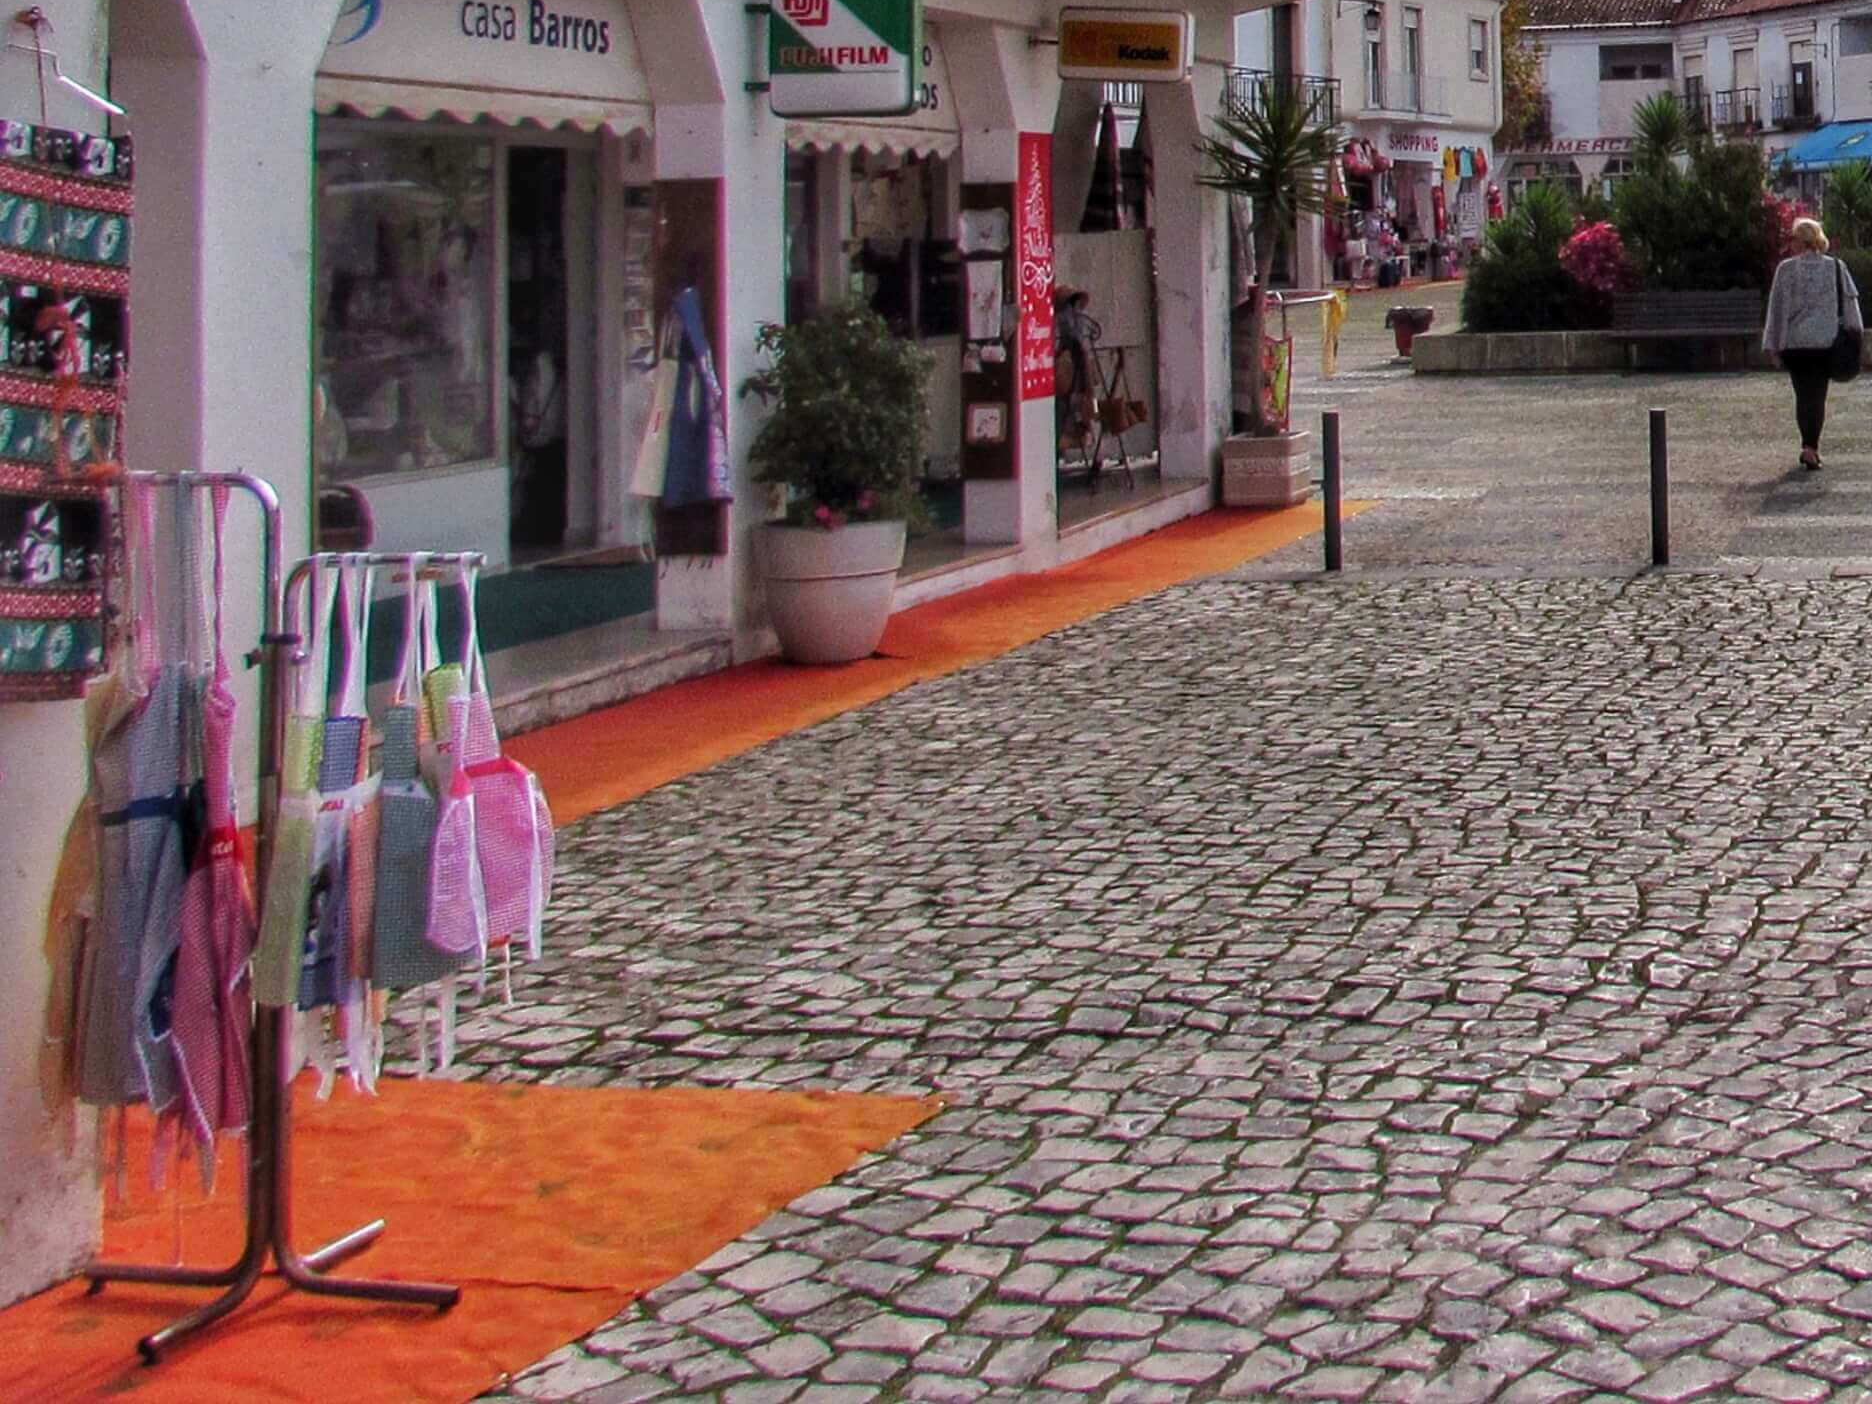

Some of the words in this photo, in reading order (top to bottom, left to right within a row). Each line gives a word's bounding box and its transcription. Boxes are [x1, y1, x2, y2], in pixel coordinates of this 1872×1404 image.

[461, 0, 517, 41] casa
[1118, 45, 1169, 61] Kodak
[1388, 132, 1440, 153] SHOPPING
